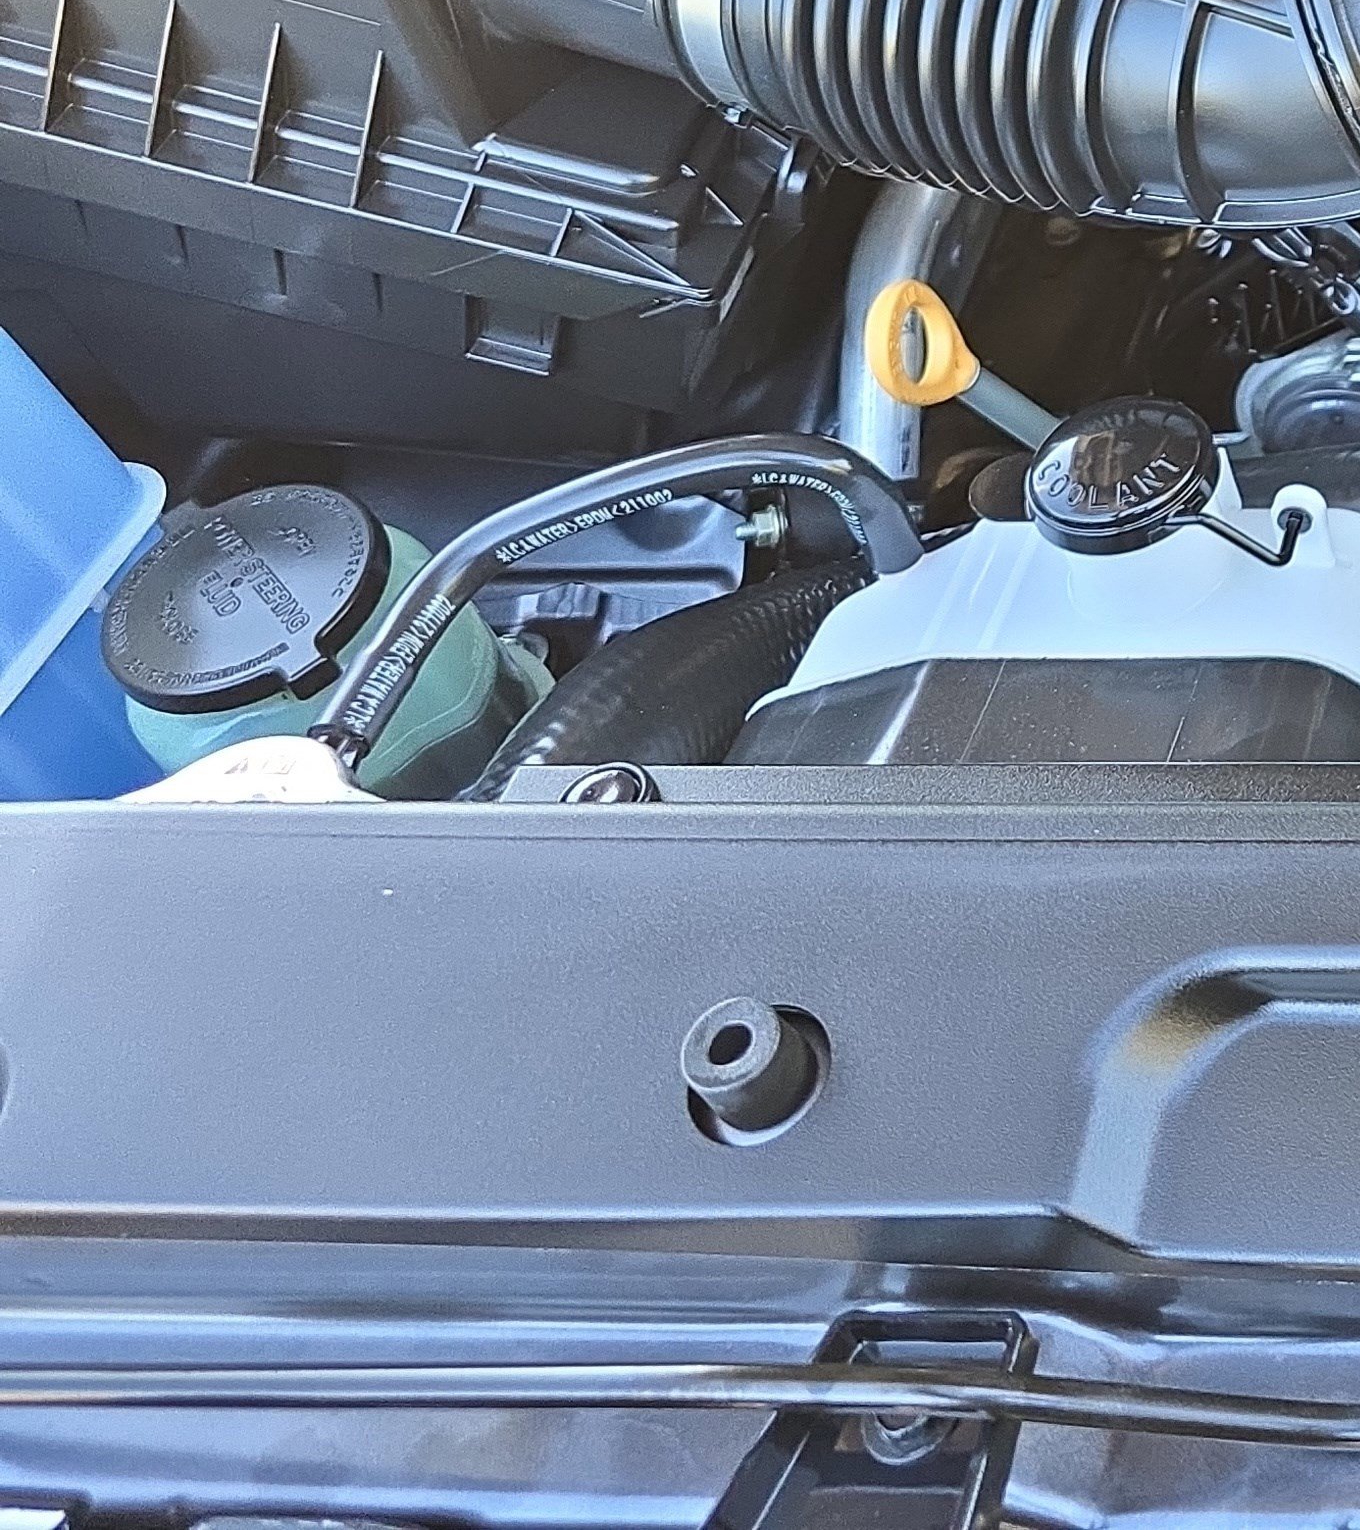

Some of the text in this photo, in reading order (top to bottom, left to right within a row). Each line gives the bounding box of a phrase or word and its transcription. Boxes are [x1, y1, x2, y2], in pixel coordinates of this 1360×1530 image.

[1037, 452, 1181, 511] COOLANT
[199, 570, 242, 617] FLUID
[240, 557, 312, 635] STEERING
